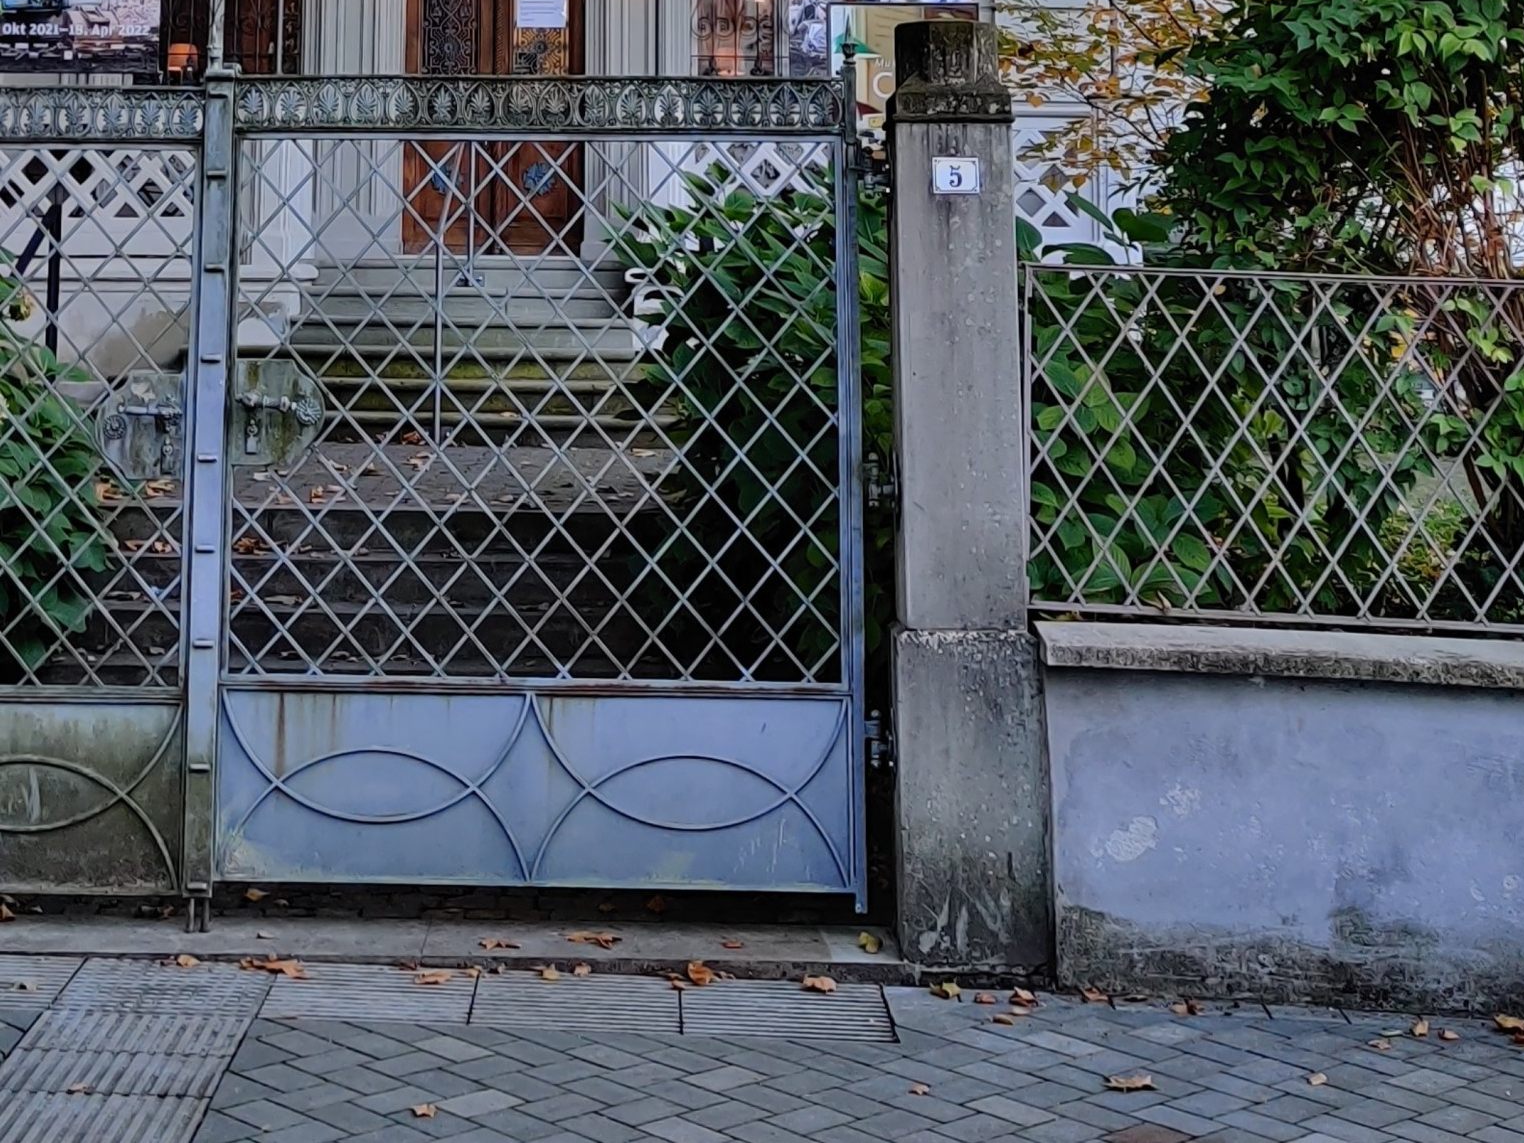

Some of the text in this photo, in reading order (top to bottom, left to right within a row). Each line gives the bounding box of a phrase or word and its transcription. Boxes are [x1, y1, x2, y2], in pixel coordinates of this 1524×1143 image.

[2, 22, 26, 36] Okt
[118, 24, 150, 36] 2022
[949, 165, 963, 188] 5
